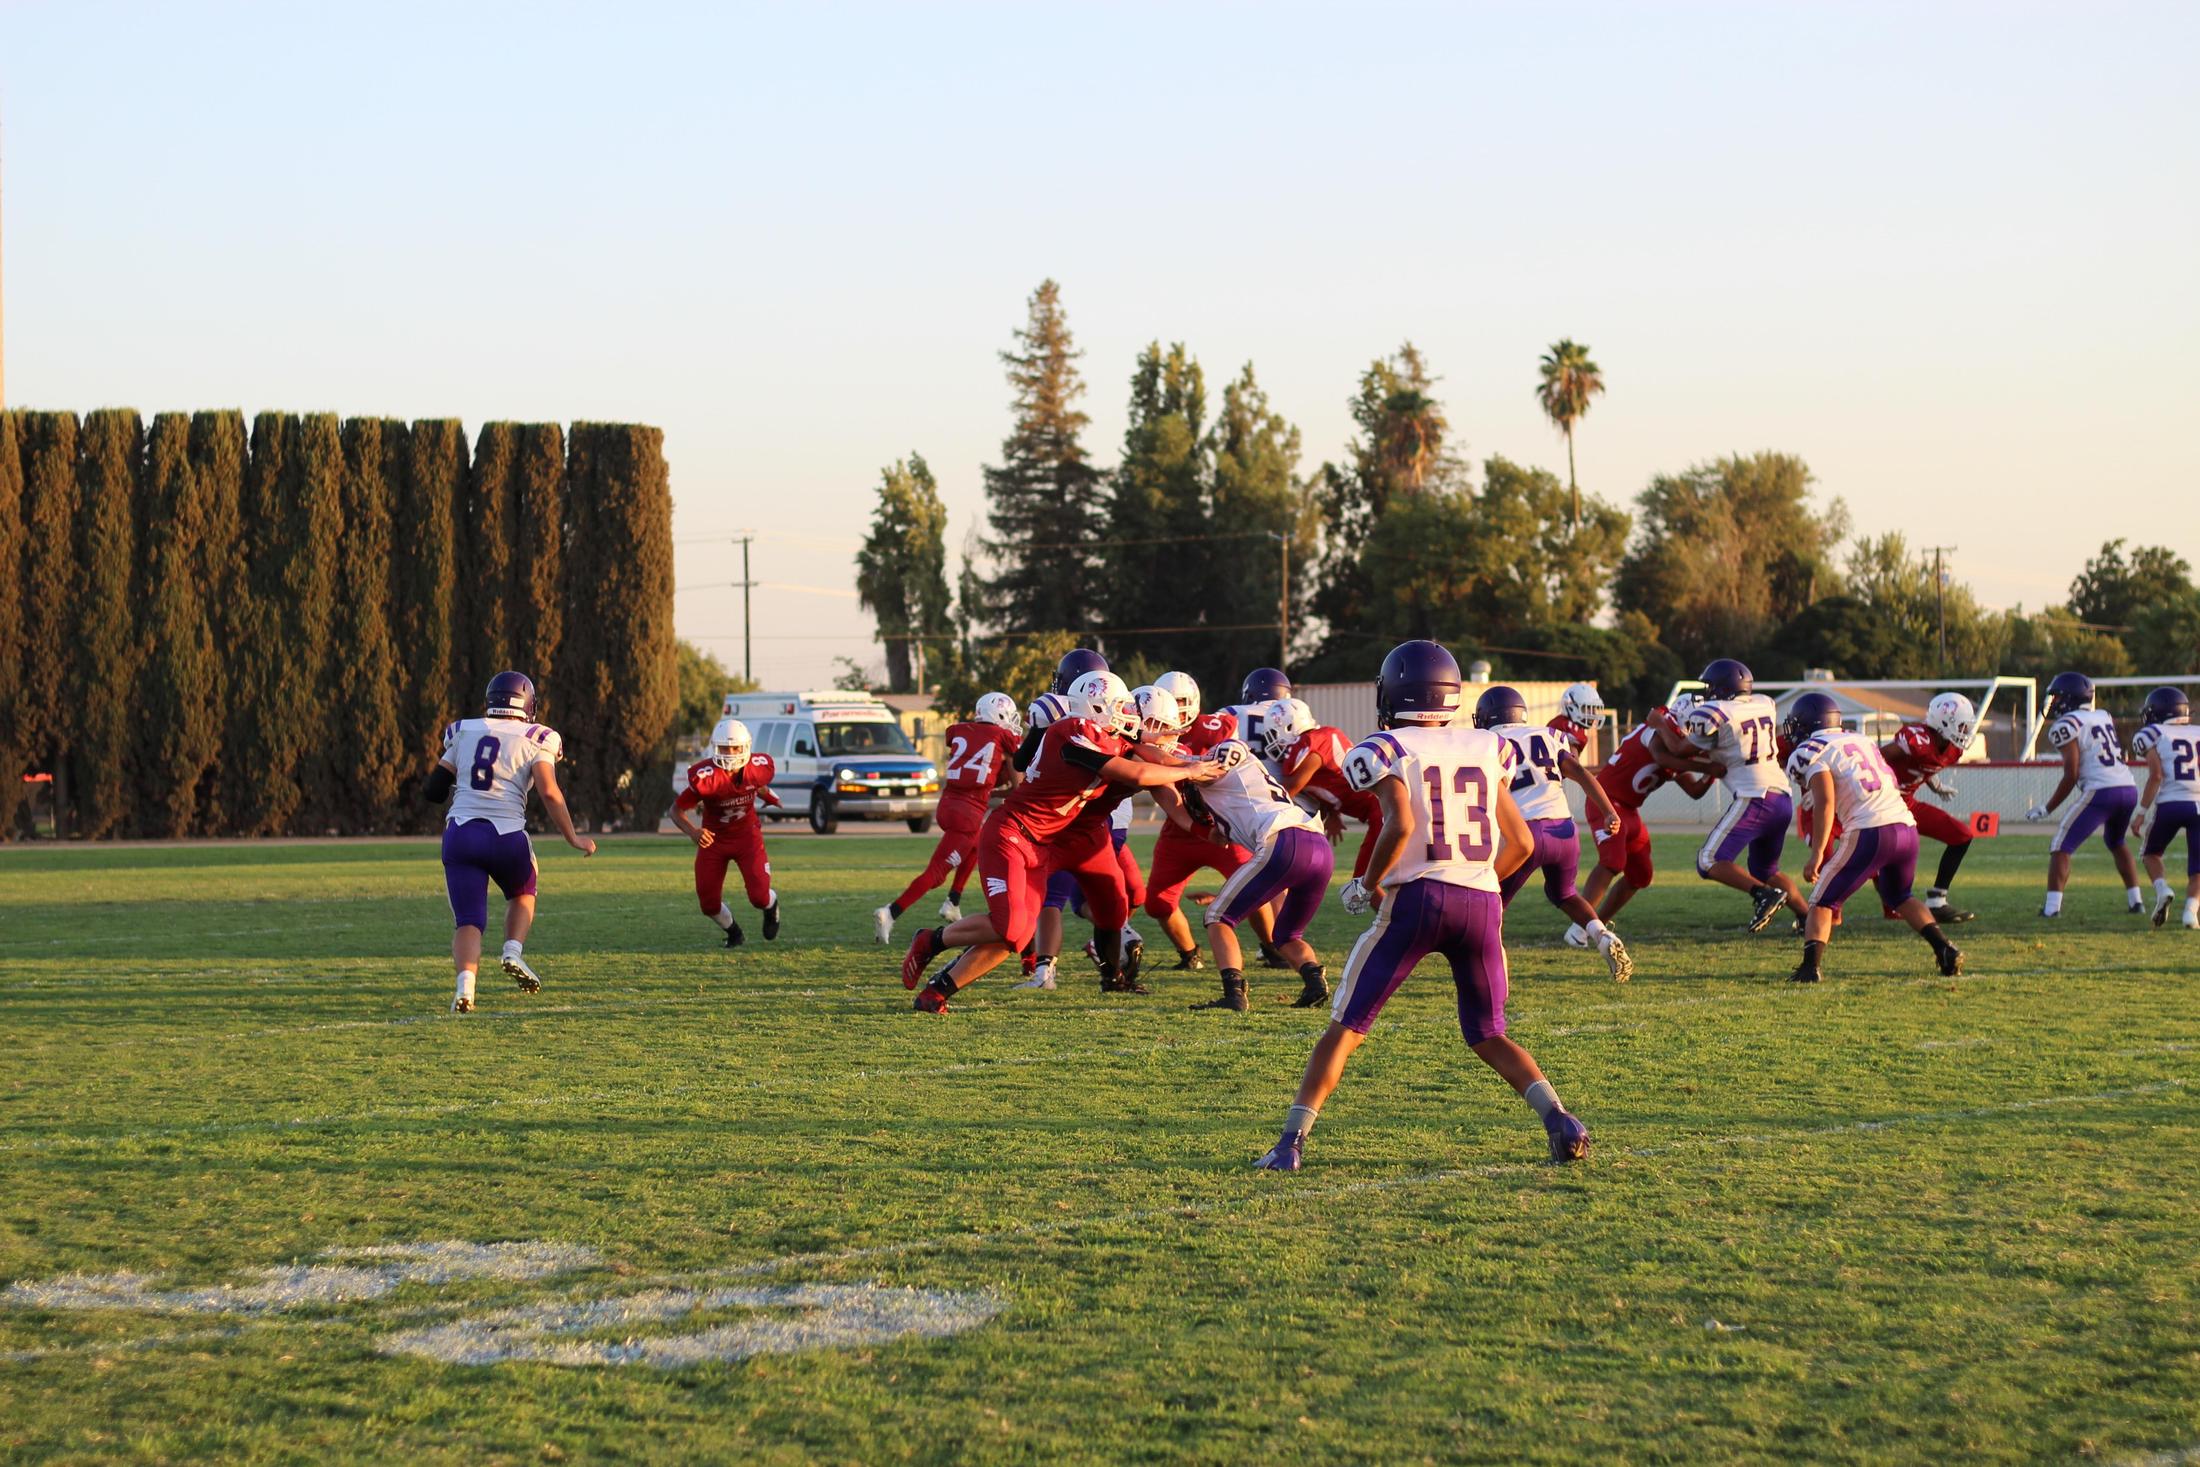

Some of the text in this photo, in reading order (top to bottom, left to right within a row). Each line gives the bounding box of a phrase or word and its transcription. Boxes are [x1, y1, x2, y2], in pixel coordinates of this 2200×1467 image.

[1217, 748, 1241, 767] 59
[1741, 716, 1774, 765] 77
[2051, 727, 2071, 744] 39
[2091, 724, 2127, 767] 39
[471, 735, 501, 791] 8
[946, 736, 996, 785] 24
[1346, 757, 1372, 790] 13
[1508, 734, 1561, 793] 24
[1423, 765, 1493, 862] 13
[1976, 815, 1990, 833] G
